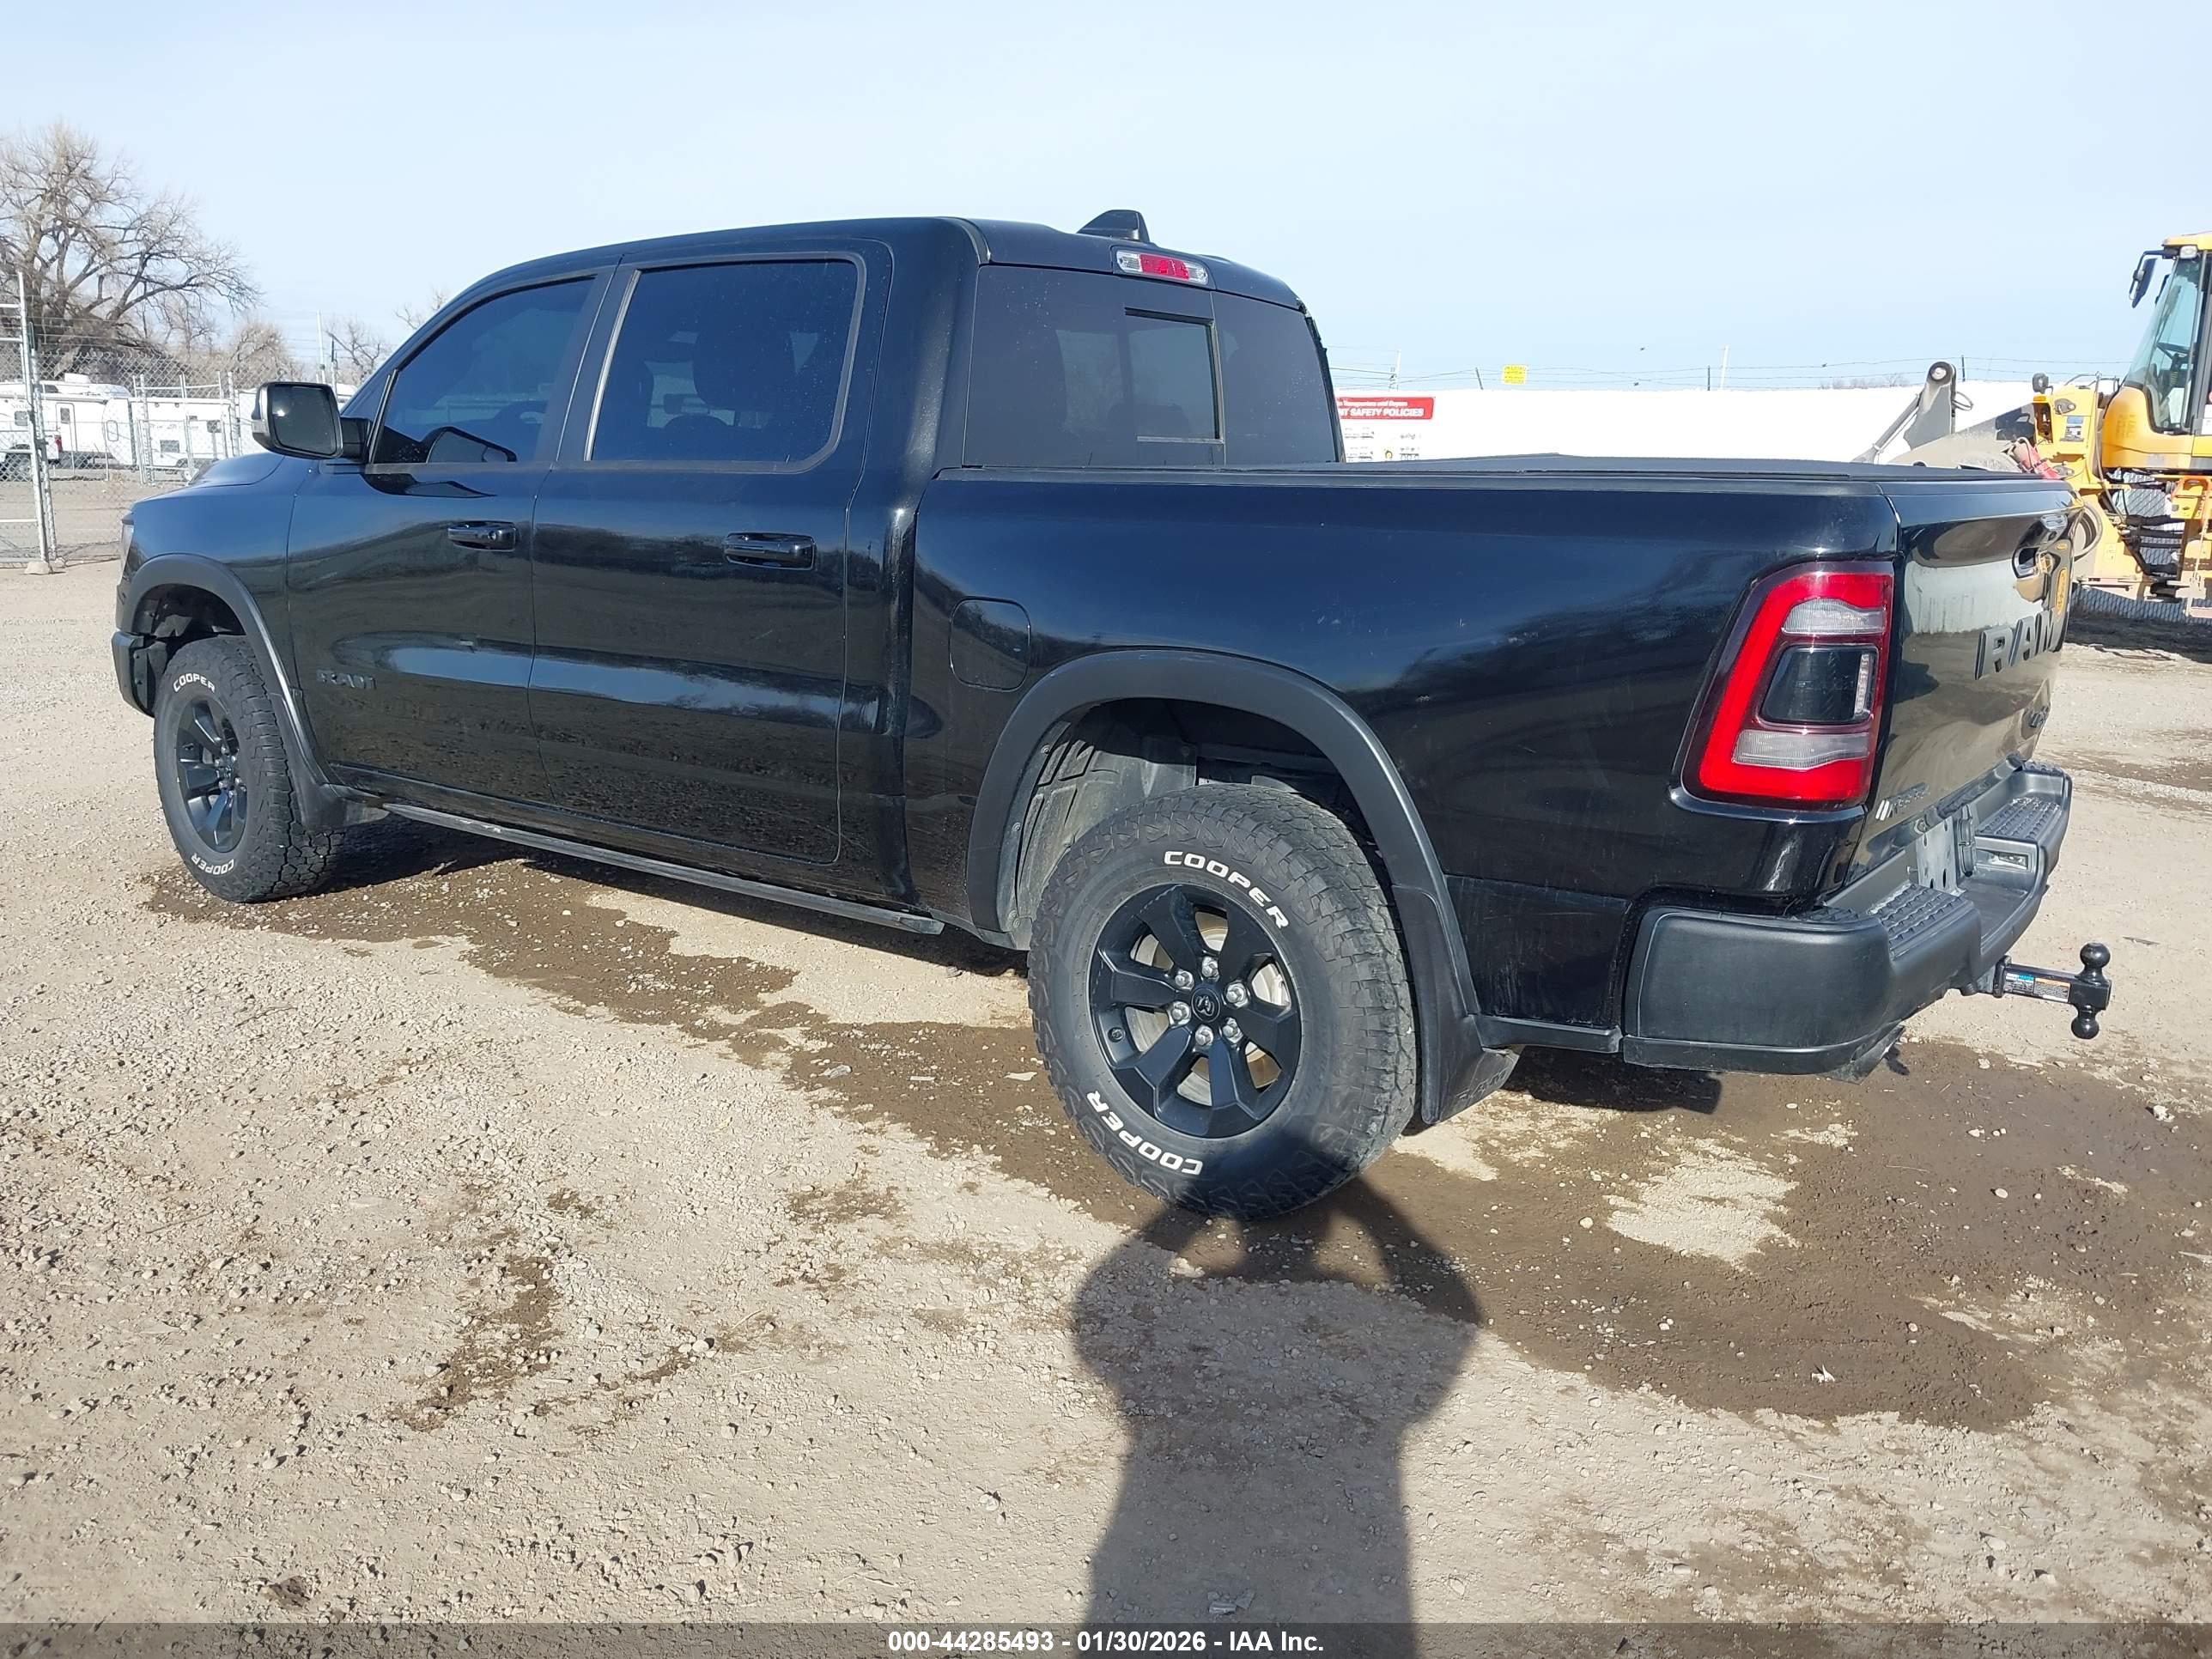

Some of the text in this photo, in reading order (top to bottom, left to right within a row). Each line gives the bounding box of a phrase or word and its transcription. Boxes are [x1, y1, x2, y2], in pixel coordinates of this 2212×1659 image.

[1350, 408, 1383, 417] SAFETY
[1383, 408, 1424, 417] POLICIES
[1975, 609, 2067, 680] RAM
[173, 672, 216, 693] COOPER
[191, 853, 234, 875] COOPER
[1164, 851, 1289, 929] COOPER
[1086, 1090, 1203, 1175] COOPER
